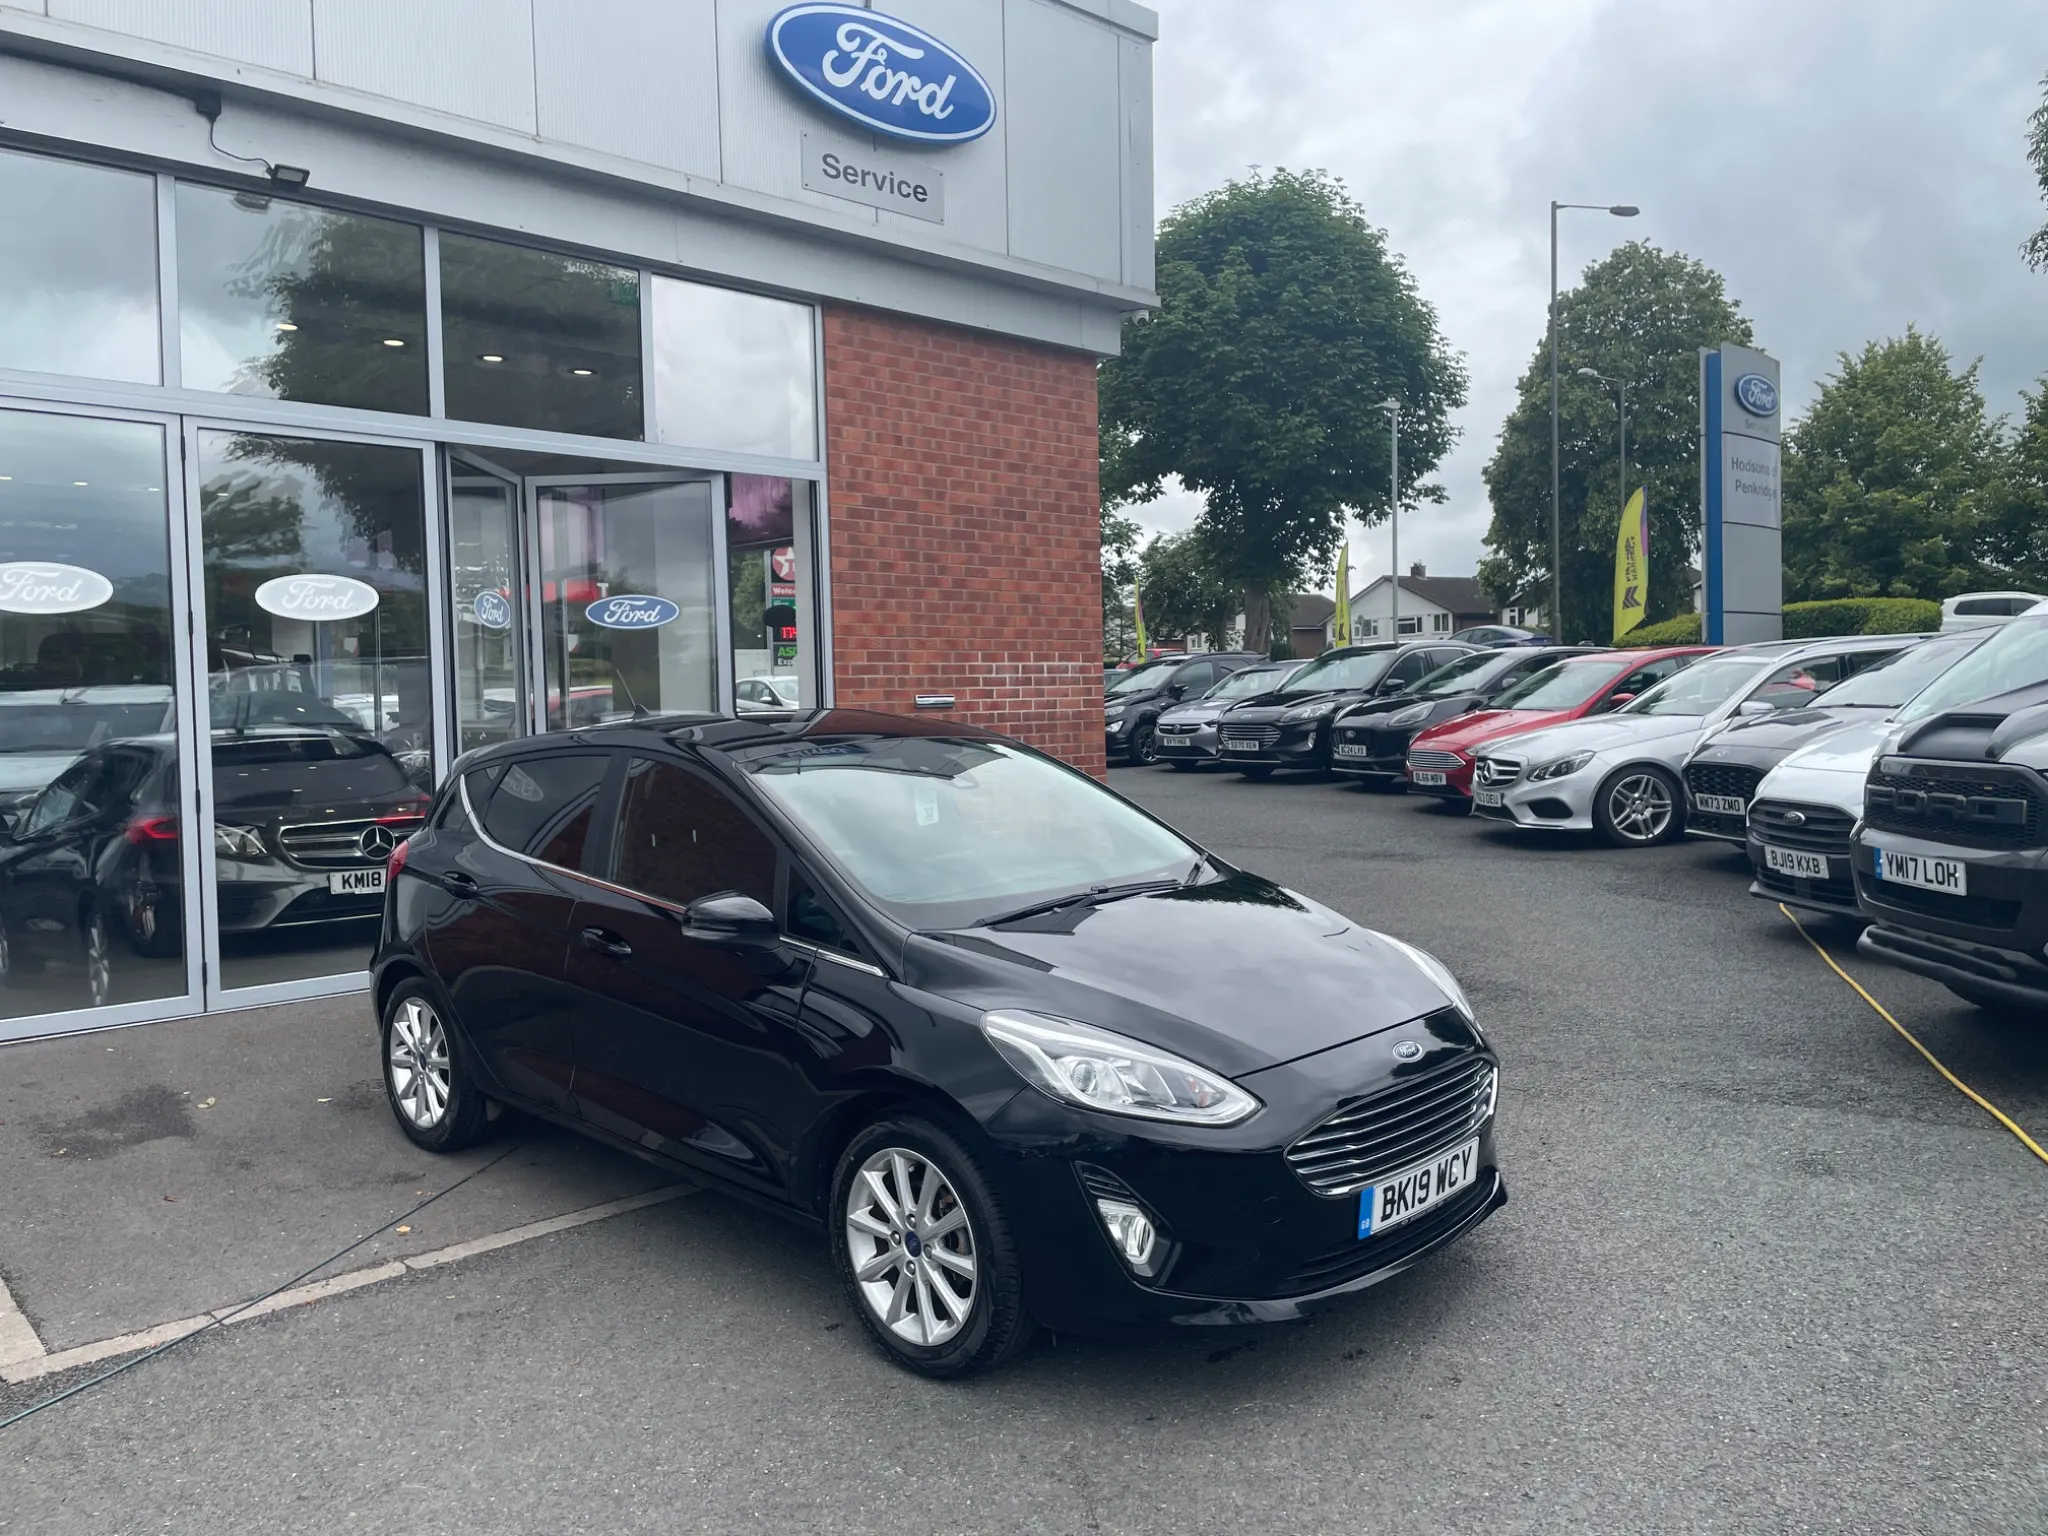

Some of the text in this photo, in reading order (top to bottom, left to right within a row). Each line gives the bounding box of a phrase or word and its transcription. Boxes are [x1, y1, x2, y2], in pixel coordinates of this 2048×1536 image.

[821, 22, 957, 120] Ford
[821, 152, 929, 203] Service
[1747, 379, 1774, 409] Ford
[1731, 457, 1771, 476] Hodsons
[0, 569, 84, 602] Ford
[282, 580, 358, 610] Ford
[481, 595, 504, 623] Ford
[603, 599, 661, 624] Ford
[1865, 785, 2028, 825] FORD
[1771, 850, 1820, 875] BJ19 KXB
[1886, 852, 1918, 881] YM17
[341, 871, 382, 890] KM18
[1380, 1168, 1431, 1223] BK19
[1436, 1145, 1473, 1197] WCY
